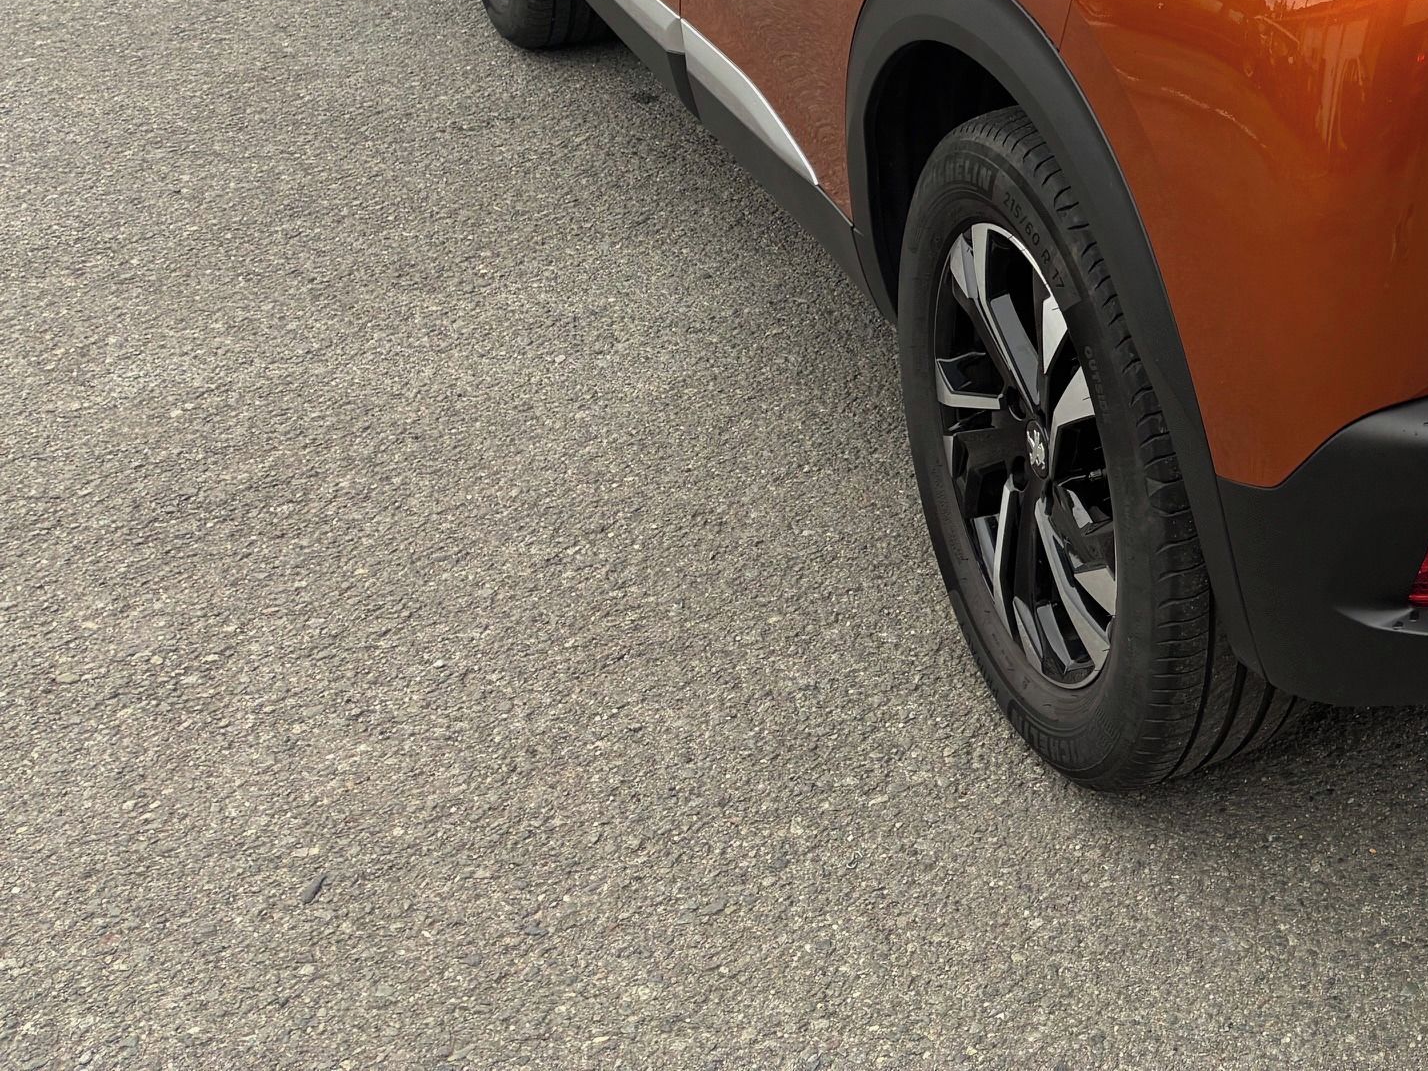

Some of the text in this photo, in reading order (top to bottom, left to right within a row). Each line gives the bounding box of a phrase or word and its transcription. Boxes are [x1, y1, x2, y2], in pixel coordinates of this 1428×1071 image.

[1002, 191, 1066, 289] 215/60 R 17
